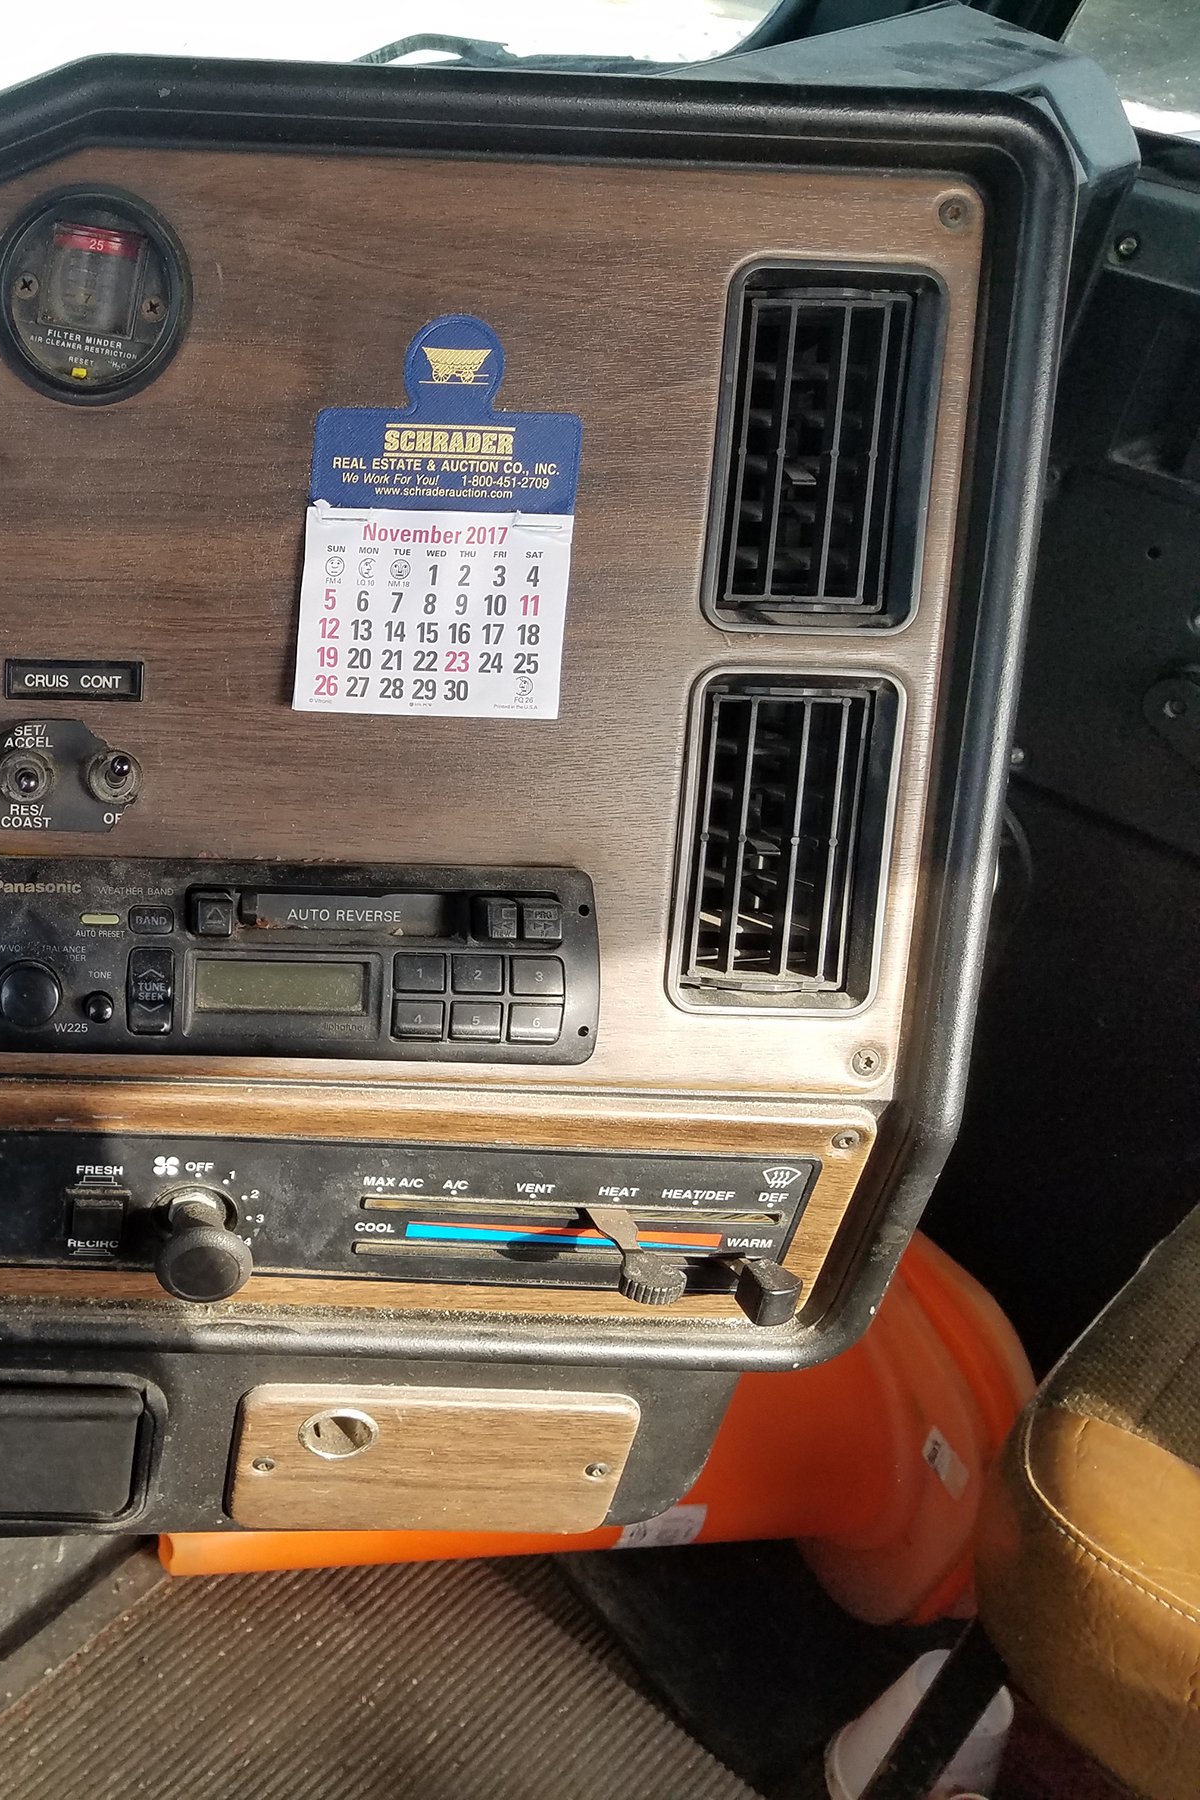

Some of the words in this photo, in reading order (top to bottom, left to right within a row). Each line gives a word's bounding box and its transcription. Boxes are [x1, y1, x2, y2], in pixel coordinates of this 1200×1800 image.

[89, 240, 104, 251] 25
[48, 329, 81, 341] FILTER
[86, 336, 122, 349] MINDER
[46, 338, 81, 350] CLEANER
[84, 345, 137, 359] RESTRICTION
[69, 356, 94, 366] RESET
[384, 430, 513, 454] SCHRADER
[332, 457, 366, 470] REAL
[372, 458, 421, 471] ESTATE
[427, 460, 436, 471] &
[441, 460, 499, 473] AUCTION
[503, 462, 529, 475] CO.,
[535, 463, 560, 475] INC.
[342, 472, 359, 483] We
[363, 473, 389, 484] Work
[394, 474, 413, 485] For
[416, 474, 439, 486] You!
[462, 475, 549, 489] 1-800-451-2709
[374, 486, 512, 499] www.schraderauction.com
[362, 522, 462, 545] November
[466, 526, 509, 545] 2017
[327, 545, 345, 553] SUN
[359, 547, 379, 555] MON
[393, 548, 411, 556] TUE
[460, 550, 476, 558] THU
[525, 551, 543, 559] SAT
[428, 564, 438, 586] 1
[458, 565, 470, 587] 2
[492, 565, 506, 587] 3
[526, 565, 539, 587] 4
[324, 589, 336, 610] 5
[357, 590, 369, 611] 6
[391, 592, 403, 613] 7
[423, 593, 436, 614] 8
[455, 593, 468, 615] 9
[484, 594, 507, 616] 10
[520, 595, 540, 616] 11
[319, 618, 340, 639] 12
[351, 620, 372, 641] 13
[384, 621, 405, 642] 14
[416, 623, 438, 643] 15
[448, 623, 470, 644] 16
[482, 624, 504, 644] 17
[517, 624, 540, 645] 18
[317, 647, 338, 668] 19
[347, 648, 371, 669] 20
[381, 650, 402, 671] 21
[413, 651, 438, 671] 22
[444, 652, 469, 672] 23
[478, 653, 503, 673] 24
[513, 653, 539, 674] 25
[24, 674, 69, 688] CRUIS
[80, 676, 122, 688] CONT
[314, 675, 338, 696] 26
[346, 677, 370, 698] 27
[379, 678, 404, 699] 28
[412, 679, 436, 700] 29
[444, 680, 468, 701] 30
[14, 724, 47, 736] SET/
[4, 737, 53, 748] ACCEL
[10, 805, 44, 816] RES/
[1, 817, 51, 828] COAST
[99, 887, 143, 895] WEATHER
[147, 888, 174, 896] BAND
[136, 915, 167, 926] BAND
[287, 909, 330, 921] AUTO
[335, 910, 401, 922] REVERSE
[76, 929, 96, 938] AUTO
[98, 930, 125, 939] PRESET
[89, 971, 111, 979] TONE
[474, 970, 481, 980] 2
[535, 971, 543, 982] 3
[138, 982, 165, 992] TUNE
[138, 992, 164, 1001] SEEK
[414, 1015, 422, 1024] 4
[472, 1016, 480, 1025] 5
[533, 1018, 541, 1027] 6
[54, 1023, 88, 1032] W225
[76, 1165, 124, 1175] FRESH
[185, 1161, 214, 1172] OFF
[229, 1170, 236, 1179] 1
[363, 1175, 395, 1188] MAX
[398, 1177, 424, 1188] A/C
[443, 1179, 469, 1191] A/C
[250, 1190, 259, 1199] 2
[516, 1183, 555, 1194] VENT
[599, 1186, 639, 1197] HEAT
[662, 1189, 735, 1201] HEAT/DEF
[758, 1191, 789, 1203] DEF
[256, 1214, 264, 1223] 3
[355, 1221, 395, 1233] COOL
[67, 1239, 119, 1248] RECIRC
[727, 1238, 773, 1250] WARM
